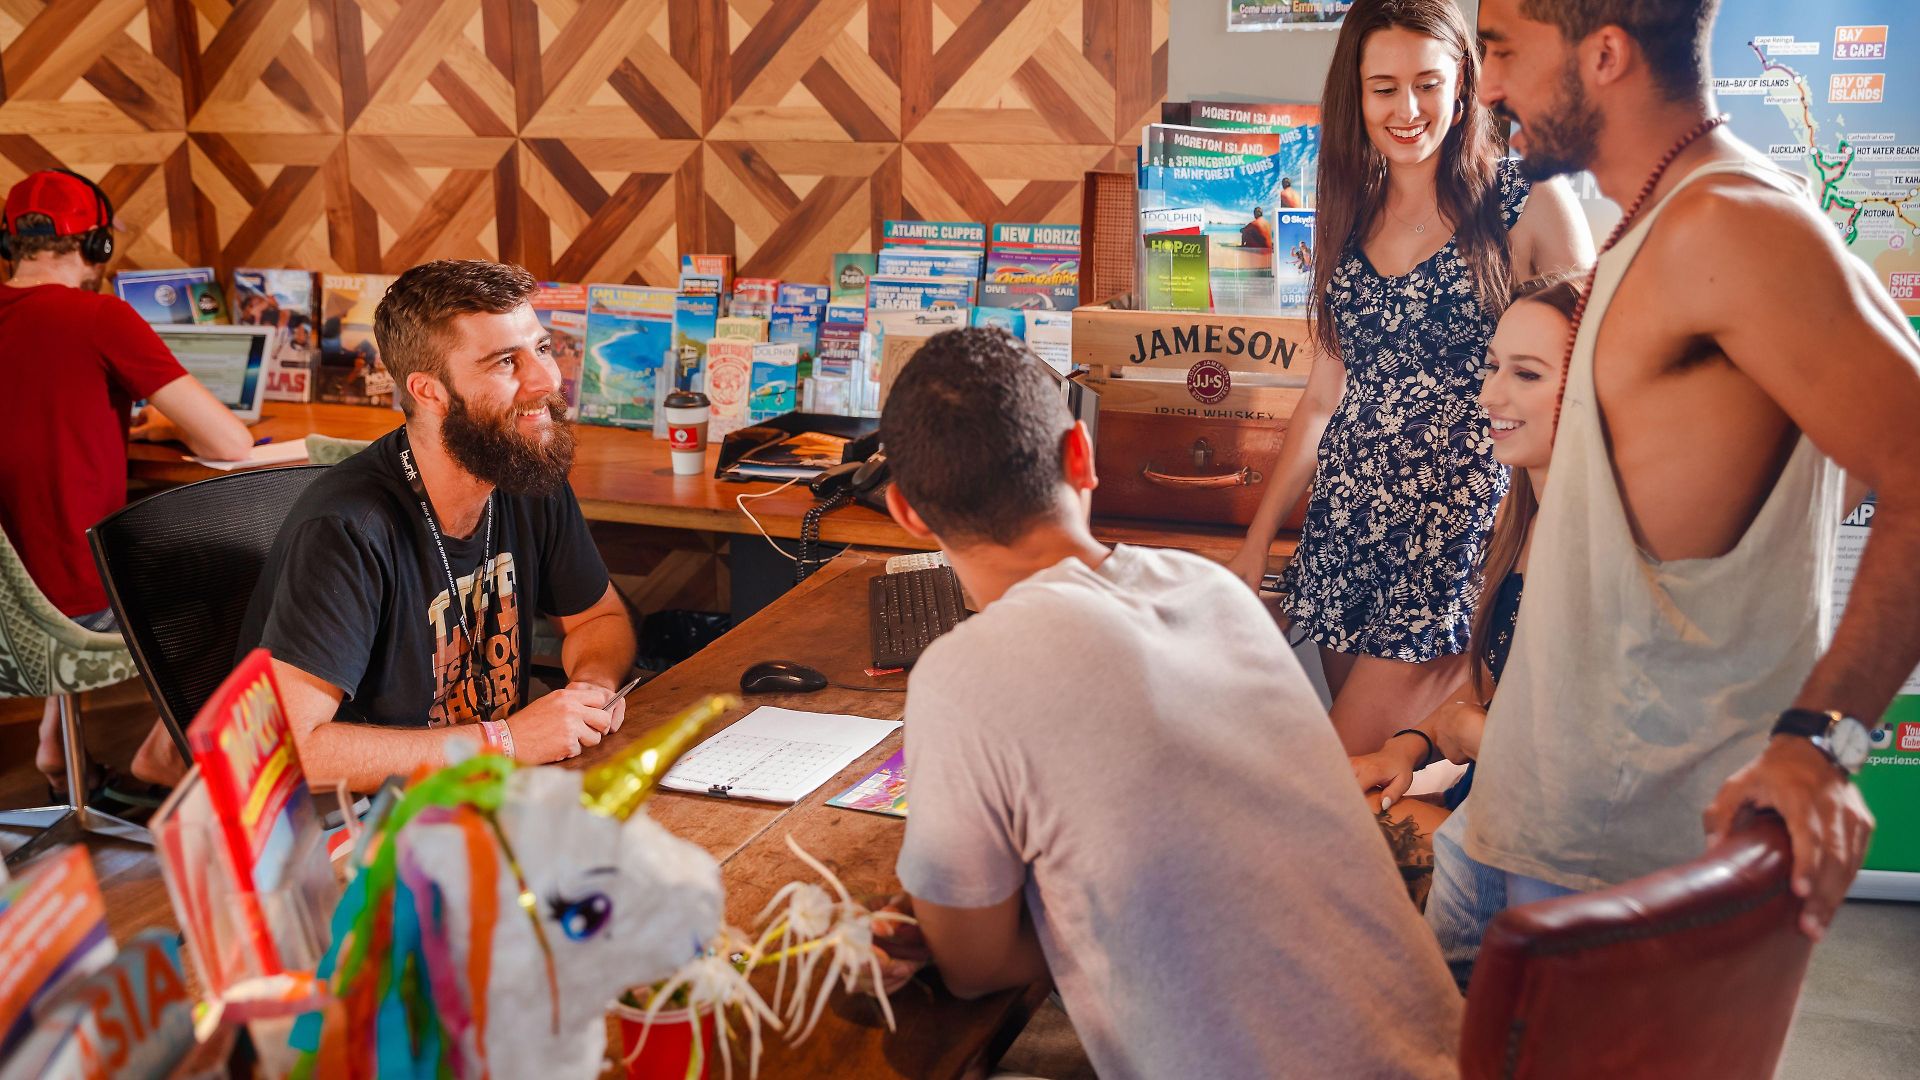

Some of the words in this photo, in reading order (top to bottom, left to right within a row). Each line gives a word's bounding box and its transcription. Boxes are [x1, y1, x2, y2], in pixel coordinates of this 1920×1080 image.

[1240, 3, 1260, 14] Come
[1261, 4, 1276, 13] and
[1277, 4, 1291, 13] see
[1839, 28, 1863, 42] BAY
[1837, 45, 1847, 57] &
[1849, 43, 1883, 57] CAPE
[1748, 79, 1758, 88] OF
[1759, 79, 1789, 87] ISLANDS
[1832, 76, 1853, 89] BAY
[1856, 76, 1872, 88] OF
[1831, 88, 1880, 100] ISLANDS
[1201, 106, 1251, 123] MORETON
[1253, 109, 1292, 126] ISLAND
[1173, 133, 1222, 152] MORETON
[1224, 139, 1264, 156] ISLAND
[1770, 146, 1806, 154] AUCKLAND
[1856, 147, 1870, 155] HOT
[1872, 147, 1895, 155] WATER
[1896, 146, 1920, 155] BEACH
[1168, 157, 1174, 168] &
[1175, 155, 1246, 168] SPRINGBROOK
[1173, 167, 1235, 180] RAINFOREST
[1239, 158, 1274, 176] TOURS
[1894, 176, 1903, 184] TE
[1149, 213, 1202, 222] DOLPHIN
[1863, 209, 1895, 217] ROTORUA
[891, 223, 938, 239] ATLANTIC
[940, 225, 983, 241] CLIPPER
[1000, 226, 1030, 242] NEW
[1151, 240, 1183, 253] HOP
[985, 285, 1006, 294] DIVE
[1054, 288, 1075, 296] SAIL
[1890, 286, 1913, 298] DOG
[876, 300, 921, 310] SAFARI
[1129, 324, 1298, 370] JAMESON
[1843, 502, 1876, 526] AP
[426, 517, 435, 532] WITH
